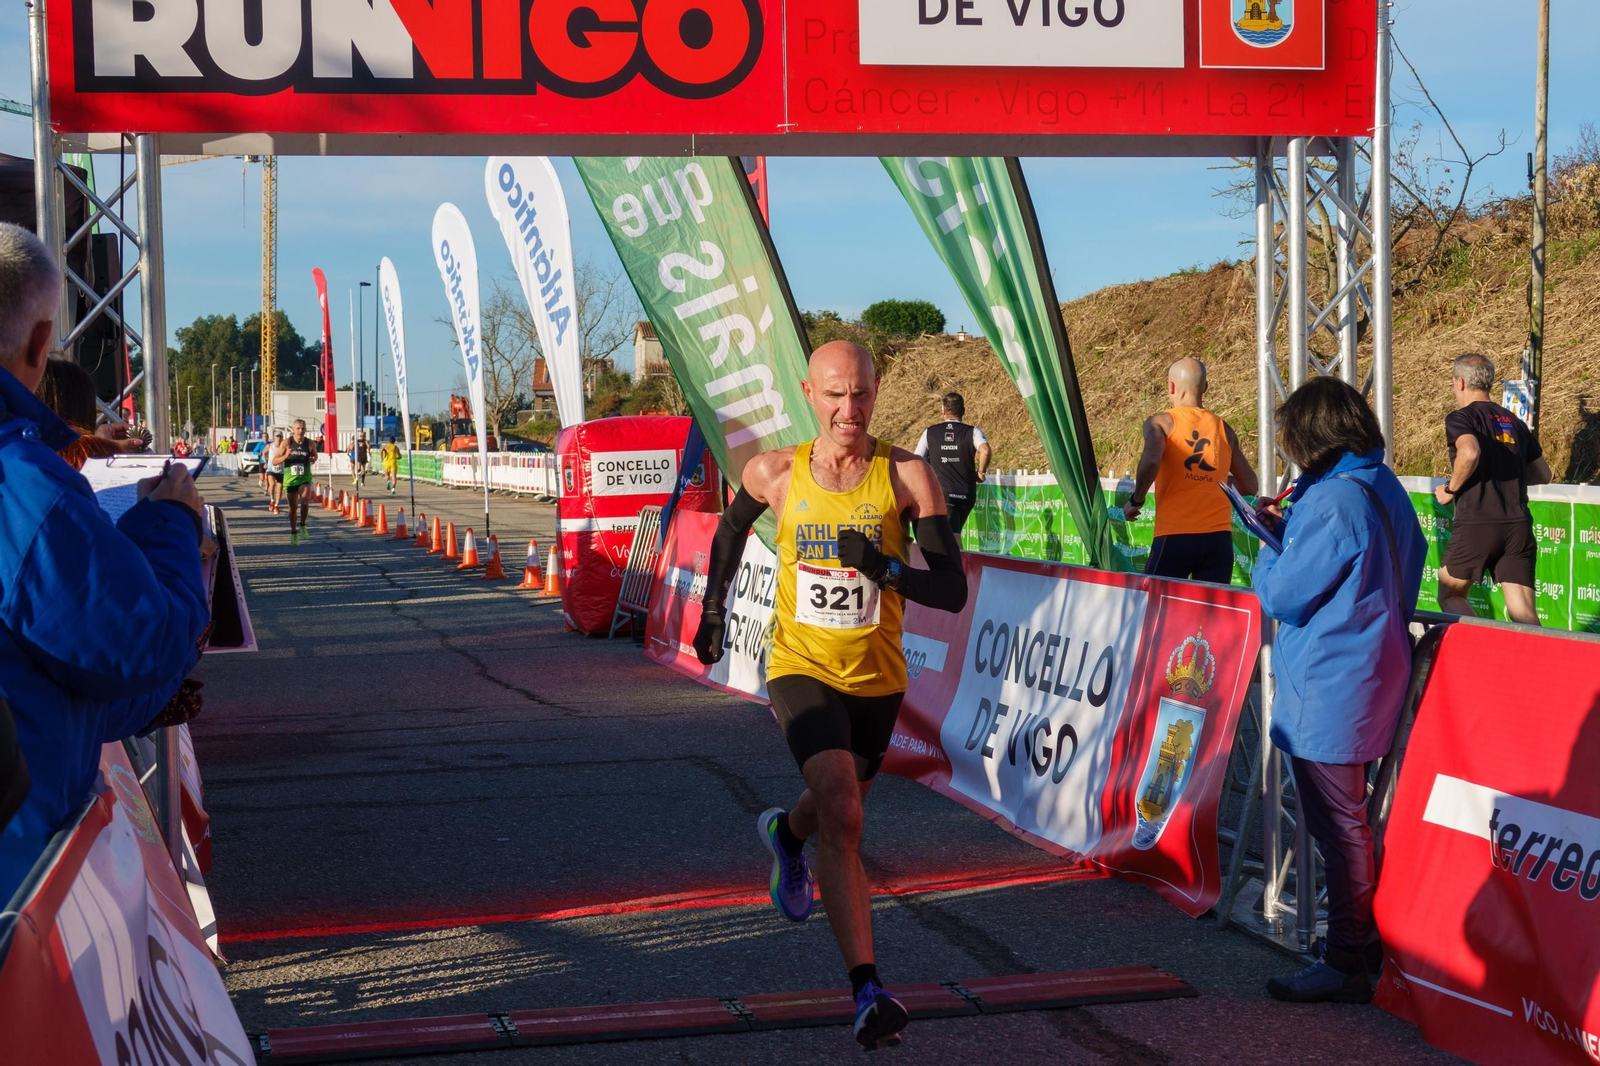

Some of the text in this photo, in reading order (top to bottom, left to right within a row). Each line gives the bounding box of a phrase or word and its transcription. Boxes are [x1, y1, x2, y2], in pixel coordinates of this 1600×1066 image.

[918, 0, 1126, 28] DE VIGO
[804, 77, 957, 115] Cáncer
[995, 79, 1088, 125] Vigo
[1108, 80, 1165, 116] +11
[1206, 82, 1251, 117] La
[1267, 82, 1306, 118] 21
[597, 459, 670, 473] CONCELLO
[606, 473, 662, 486] DE VIGO
[1184, 472, 1213, 483] Moaña
[1543, 526, 1566, 544] auga
[797, 544, 824, 559] SAN
[809, 583, 864, 611] 321
[1542, 582, 1564, 600] auga
[1577, 583, 1600, 602] máis
[974, 618, 1114, 708] CONCELLO
[908, 737, 927, 755] PARA
[964, 696, 1078, 785] DE VIGO
